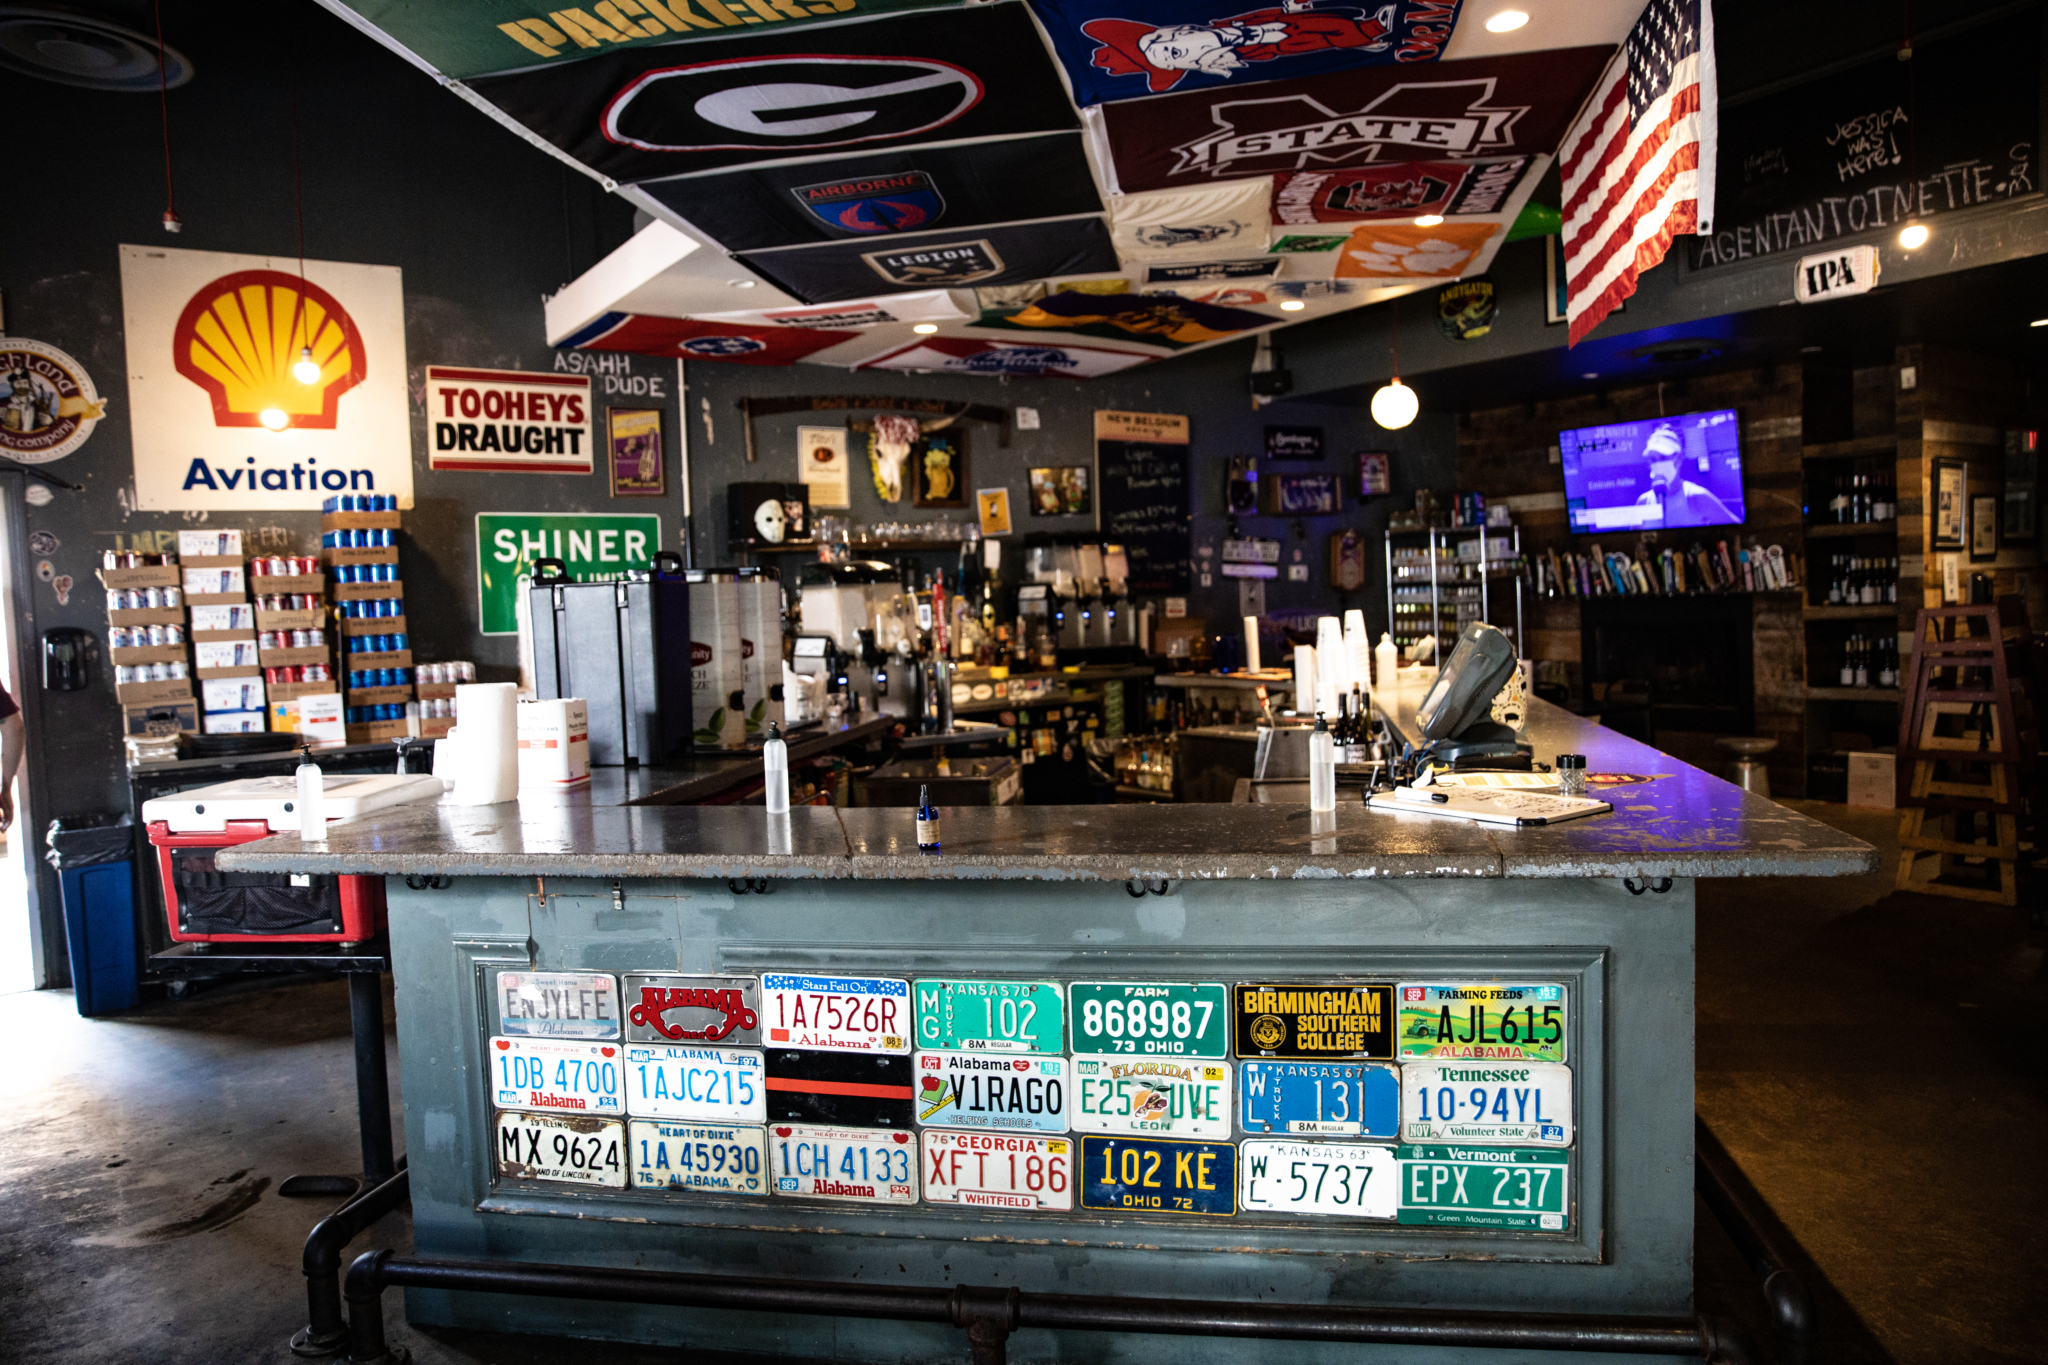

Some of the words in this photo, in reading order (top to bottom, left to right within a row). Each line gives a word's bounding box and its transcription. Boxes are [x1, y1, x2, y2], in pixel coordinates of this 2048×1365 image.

[1233, 119, 1457, 155] STATE
[809, 174, 921, 199] AIRBORNE
[886, 247, 976, 268] LEGION
[1804, 255, 1857, 297] IPA
[553, 351, 631, 374] ASAHH
[605, 375, 666, 397] DUDE
[439, 387, 585, 424] TOOHEYS
[436, 422, 585, 455] DRAUGHT
[182, 457, 375, 490] Aviation
[494, 529, 647, 563] SHINER
[802, 979, 828, 992] Stars
[829, 980, 849, 992] Fell
[850, 982, 867, 993] On
[946, 984, 1010, 998] KANSAS
[1013, 985, 1031, 998] 70
[1124, 987, 1170, 998] FARM
[1244, 991, 1381, 1014] BIRMINGHAM
[1407, 990, 1422, 1001] SEP
[1438, 990, 1488, 1000] FARMING
[1489, 990, 1523, 1000] FEEDS
[776, 993, 897, 1034] 1A7526R
[983, 998, 1038, 1040] 102
[1083, 1000, 1214, 1040] 868987
[537, 1022, 584, 1036] Alabama
[1297, 1015, 1381, 1033] SOUTHERN
[1437, 1005, 1561, 1044] AJL615
[798, 1033, 871, 1049] Alabama
[969, 1041, 986, 1049] 8M
[991, 1041, 1013, 1049] REGULAR
[1112, 1040, 1136, 1052] 73
[1144, 1040, 1185, 1053] OHIO
[1297, 1033, 1365, 1051] COLLEGE
[631, 1052, 649, 1062] MAR
[665, 1048, 723, 1064] ALABAMA
[1438, 1046, 1524, 1058] ALABAMA
[743, 1058, 755, 1066] 97
[924, 1059, 939, 1069] OCT
[949, 1057, 1011, 1071] Alabama
[1079, 1064, 1098, 1074] MAR
[500, 1056, 544, 1090] 1DB
[555, 1059, 616, 1094] 4700
[1110, 1063, 1192, 1082] FLORIDA
[1276, 1066, 1341, 1078] KANSAS
[1344, 1068, 1363, 1079] 67
[1438, 1067, 1530, 1082] Tennessee
[638, 1065, 754, 1105] 1AJC215
[530, 1091, 586, 1109] Alabama
[1082, 1079, 1131, 1115] E25
[1169, 1083, 1220, 1121] UVE
[1314, 1080, 1364, 1122] 131
[1418, 1086, 1553, 1122] 10-94YL
[530, 1119, 540, 1127] 19
[950, 1115, 988, 1126] HELPING
[993, 1117, 1032, 1127] SCHOOLS
[1131, 1121, 1170, 1131] LEON
[1298, 1122, 1318, 1132] 8M
[1321, 1123, 1344, 1131] REGULAR
[659, 1128, 692, 1138] HEART
[693, 1129, 707, 1139] OF
[708, 1130, 735, 1141] DIXIE
[1410, 1125, 1430, 1137] NOV
[1450, 1127, 1495, 1137] Volunteer
[1499, 1127, 1524, 1137] State
[1547, 1126, 1560, 1136] 87
[502, 1127, 543, 1165] MX
[553, 1134, 620, 1172] 9624
[930, 1134, 948, 1145] 76
[957, 1135, 1037, 1153] GEORGIA
[640, 1140, 669, 1169] 1A
[680, 1142, 759, 1175] 45930
[1277, 1145, 1344, 1159] KANSAS
[1350, 1148, 1366, 1161] 63
[1447, 1147, 1516, 1162] Vermont
[779, 1141, 829, 1177] 1CH
[840, 1146, 910, 1184] 4133
[930, 1148, 989, 1188] XFT
[1007, 1153, 1067, 1193] 186
[1100, 1147, 1162, 1188] 102
[1175, 1151, 1216, 1191] KE
[552, 1169, 561, 1177] OF
[562, 1170, 592, 1180] LINCOLN
[637, 1172, 654, 1183] 76
[669, 1174, 730, 1188] ALABAMA
[781, 1180, 797, 1190] SEP
[813, 1179, 875, 1198] Alabama
[1411, 1165, 1469, 1204] EPX
[1492, 1168, 1551, 1207] 237
[965, 1193, 1031, 1208] WHITFIELD
[1122, 1195, 1161, 1208] OHIO
[1173, 1197, 1193, 1210] 72
[1437, 1214, 1460, 1222] Green
[1465, 1215, 1503, 1225] Mountain
[1507, 1218, 1526, 1226] State
